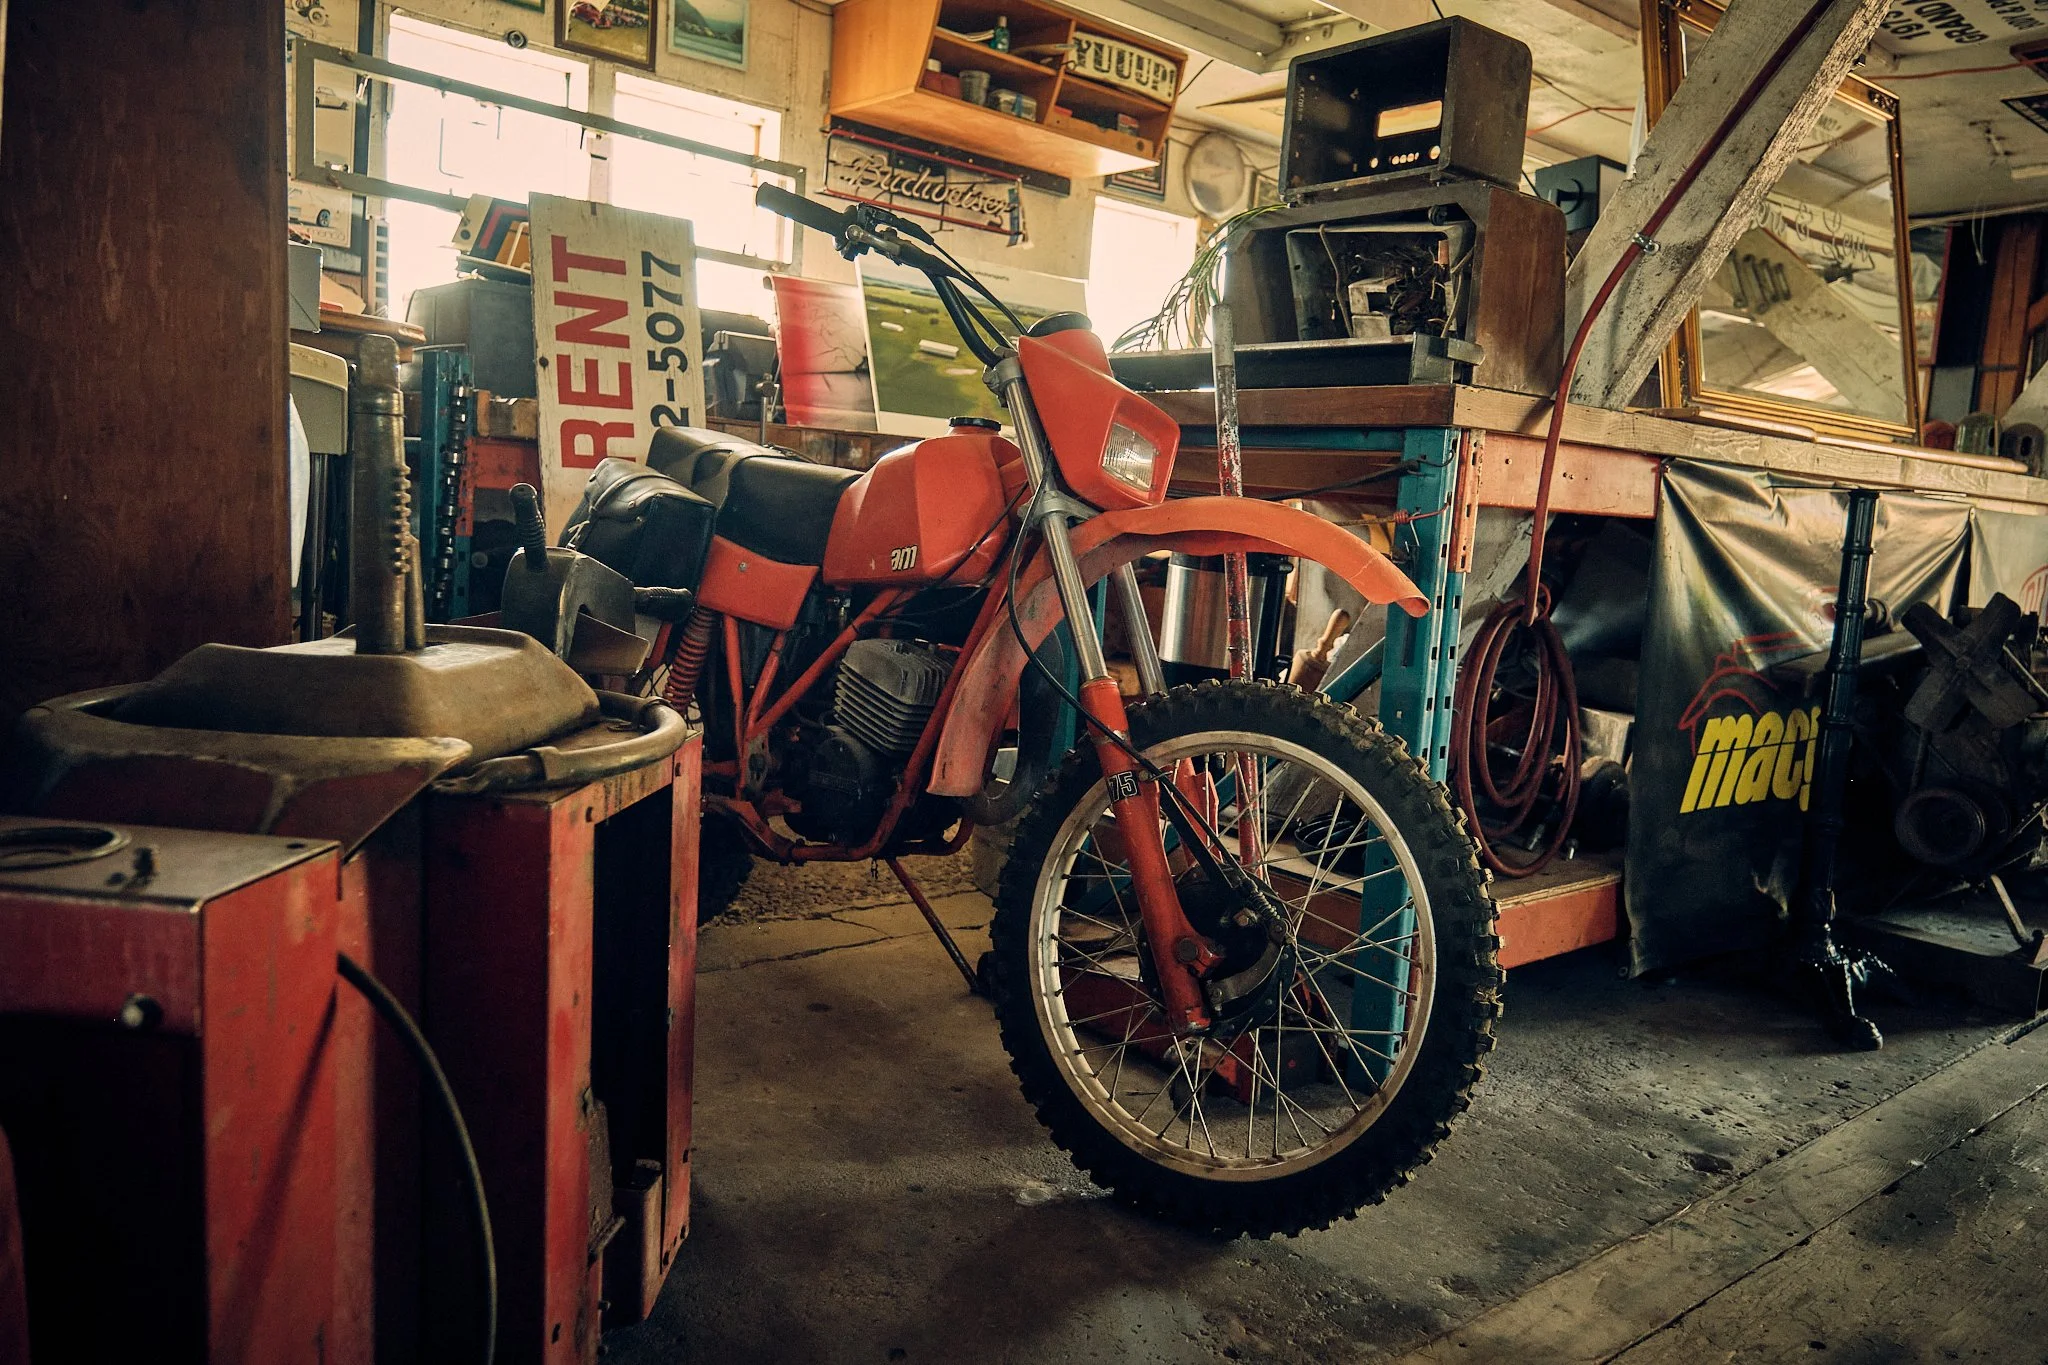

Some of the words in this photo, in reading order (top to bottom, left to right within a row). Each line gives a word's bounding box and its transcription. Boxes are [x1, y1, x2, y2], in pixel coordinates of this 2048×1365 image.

[1915, 1, 1989, 44] GRAND
[835, 152, 1016, 217] Budweiser
[551, 234, 637, 470] RENT
[641, 250, 690, 428] 2-5077
